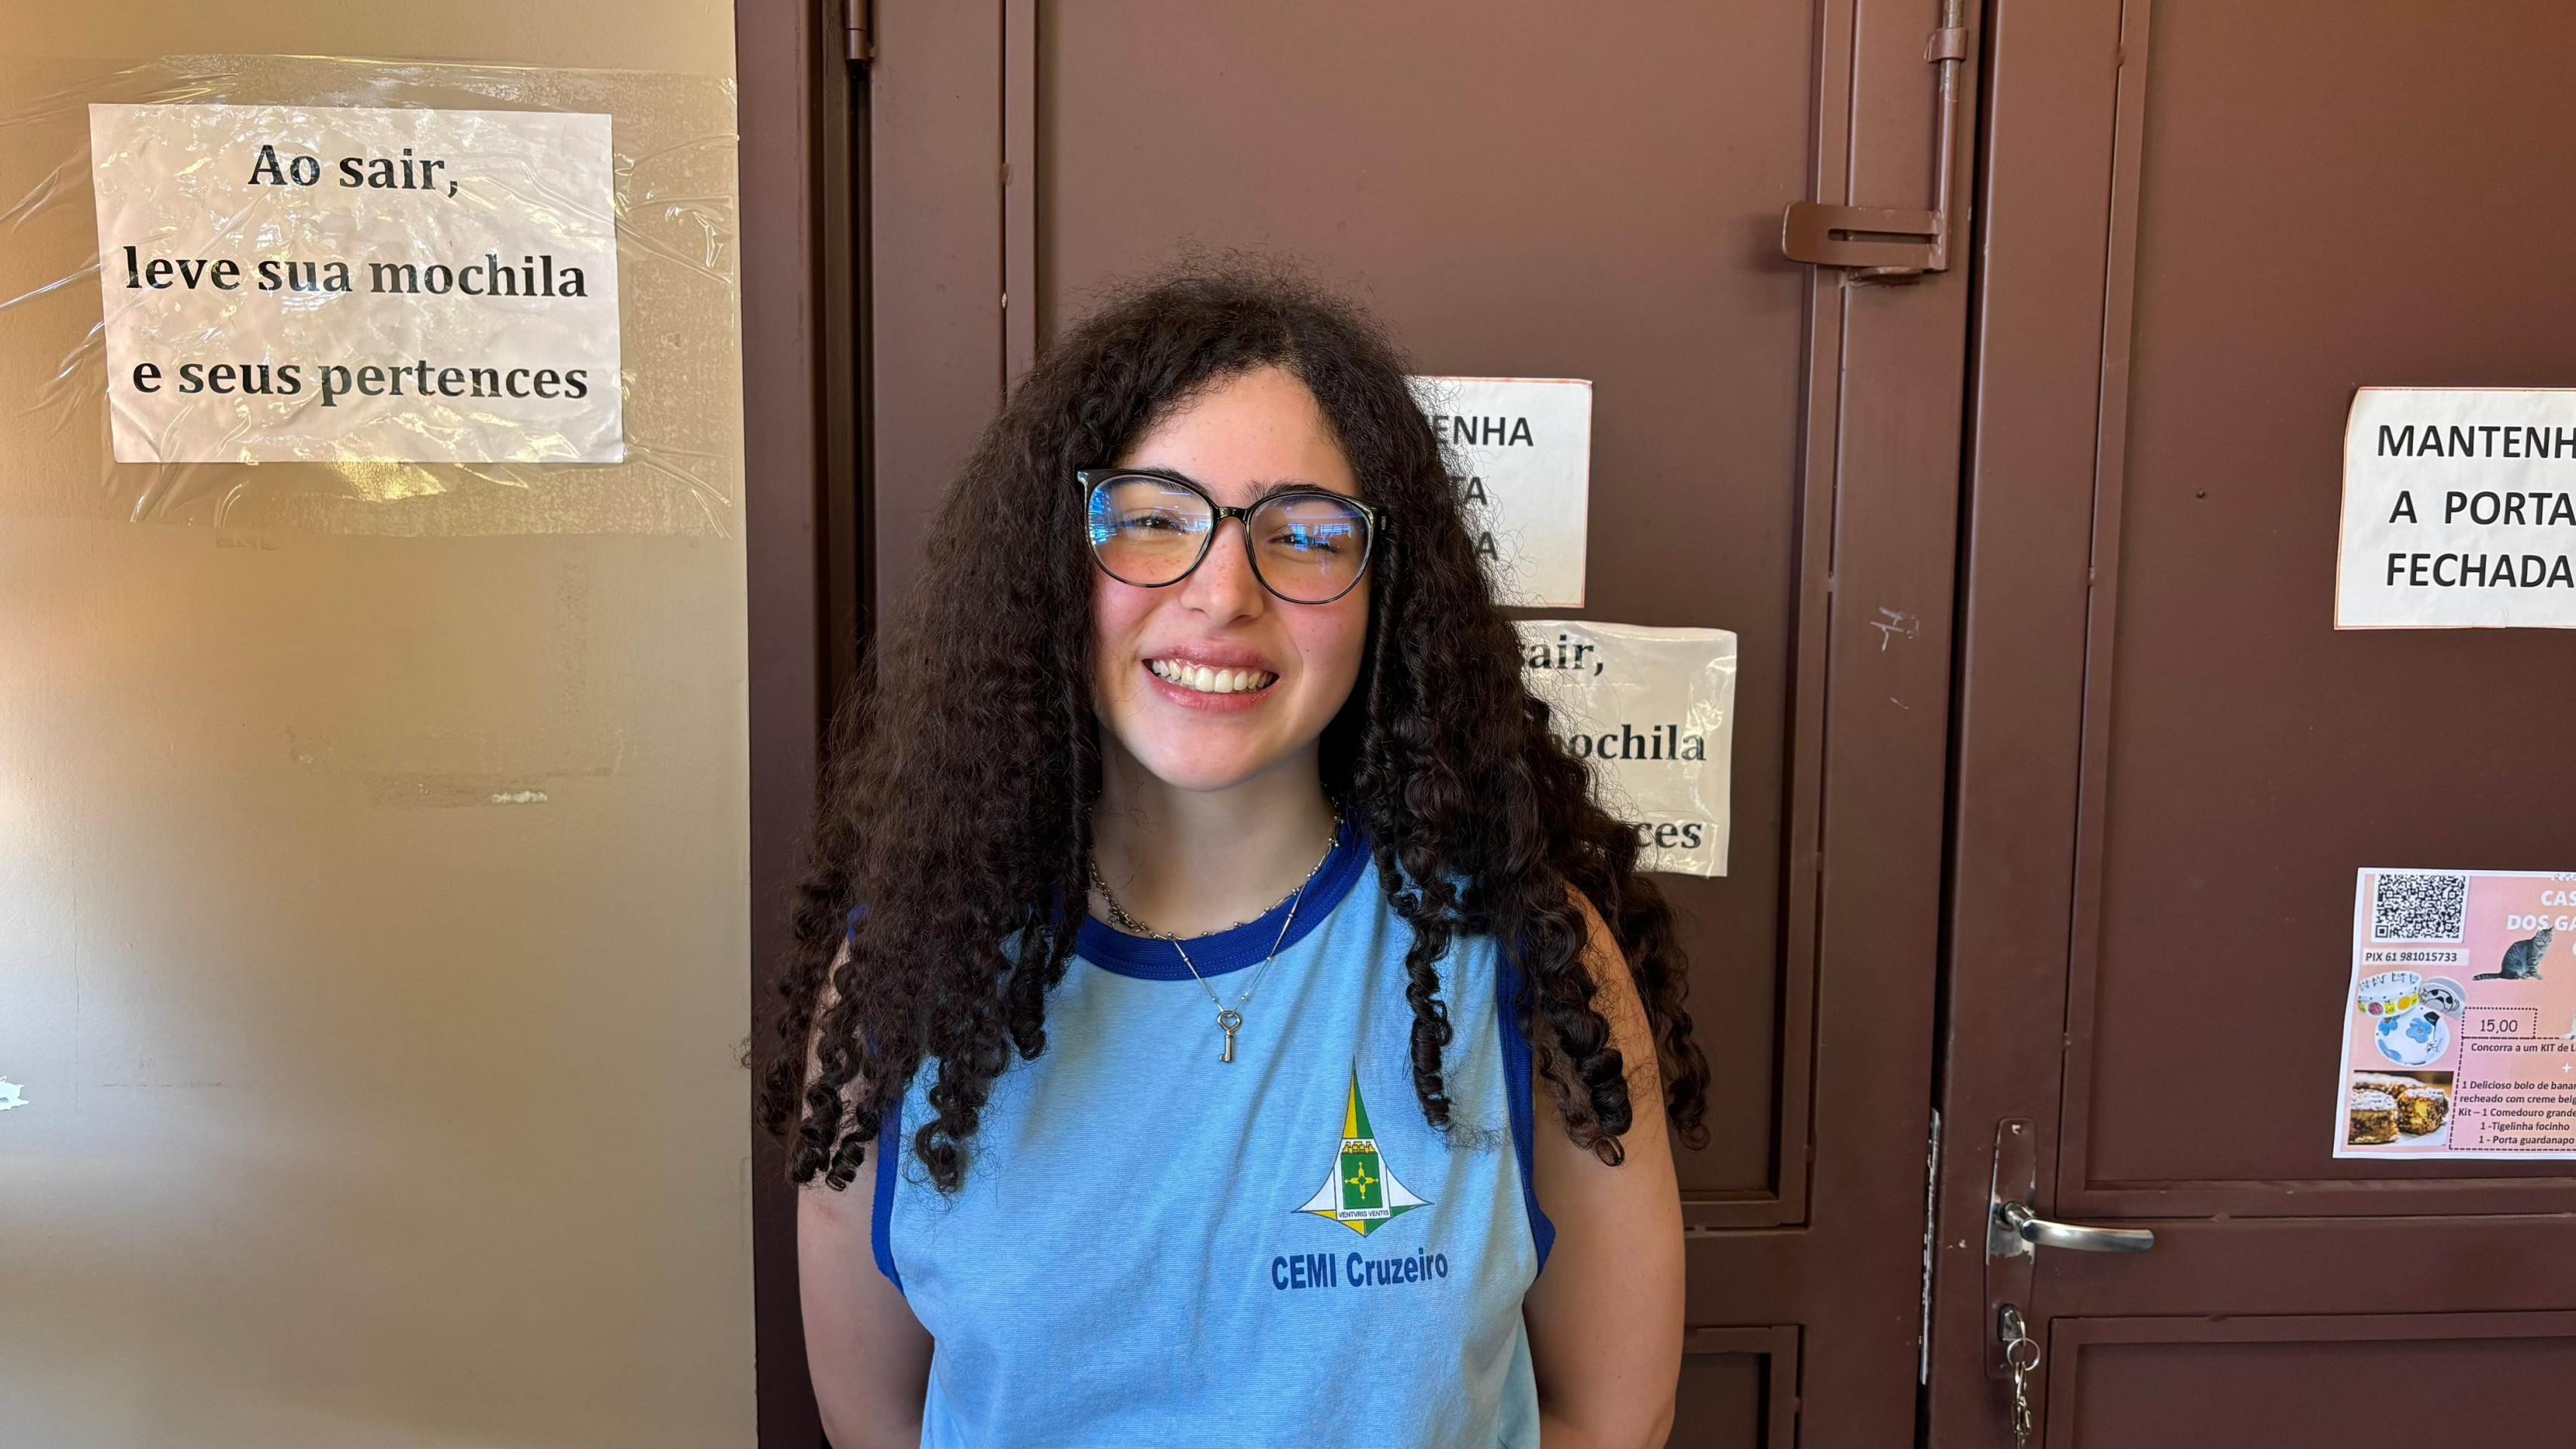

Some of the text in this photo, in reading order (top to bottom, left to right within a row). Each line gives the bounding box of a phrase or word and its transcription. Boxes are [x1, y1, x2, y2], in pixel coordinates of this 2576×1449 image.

[248, 144, 459, 199] Ao sair,
[123, 246, 588, 299] leve sua mochila
[133, 358, 588, 408] e seus pertences
[1430, 415, 1534, 447] ENHA
[2378, 424, 2576, 459] MANTENH
[2388, 490, 2576, 526] A PORTA
[2386, 553, 2575, 589] FECHADA
[1518, 634, 1603, 677] air,
[1558, 723, 1707, 761] ochila
[2507, 914, 2550, 931] DOS
[2366, 952, 2458, 962] PIX 61 981015733
[2480, 1019, 2518, 1034] 15,00
[2471, 1043, 2513, 1052] Concorra
[2541, 1043, 2555, 1052] KIT
[2557, 1043, 2569, 1052] de
[2459, 1095, 2504, 1103] recheado
[2462, 1081, 2467, 1089] 1
[2470, 1081, 2512, 1089] Delicioso
[2514, 1081, 2535, 1090] bolo
[2537, 1081, 2549, 1090] de
[2458, 1107, 2471, 1117] Kit
[2483, 1108, 2487, 1117] 1
[2490, 1107, 2544, 1117] Comedouro
[2480, 1122, 2486, 1130] 1
[2535, 1122, 2570, 1131] focinho
[2479, 1135, 2484, 1144] 1
[2492, 1135, 2517, 1144] Porta
[2519, 1136, 2574, 1146] guardanapo
[1272, 1248, 1448, 1290] CEMI Cruzeiro
